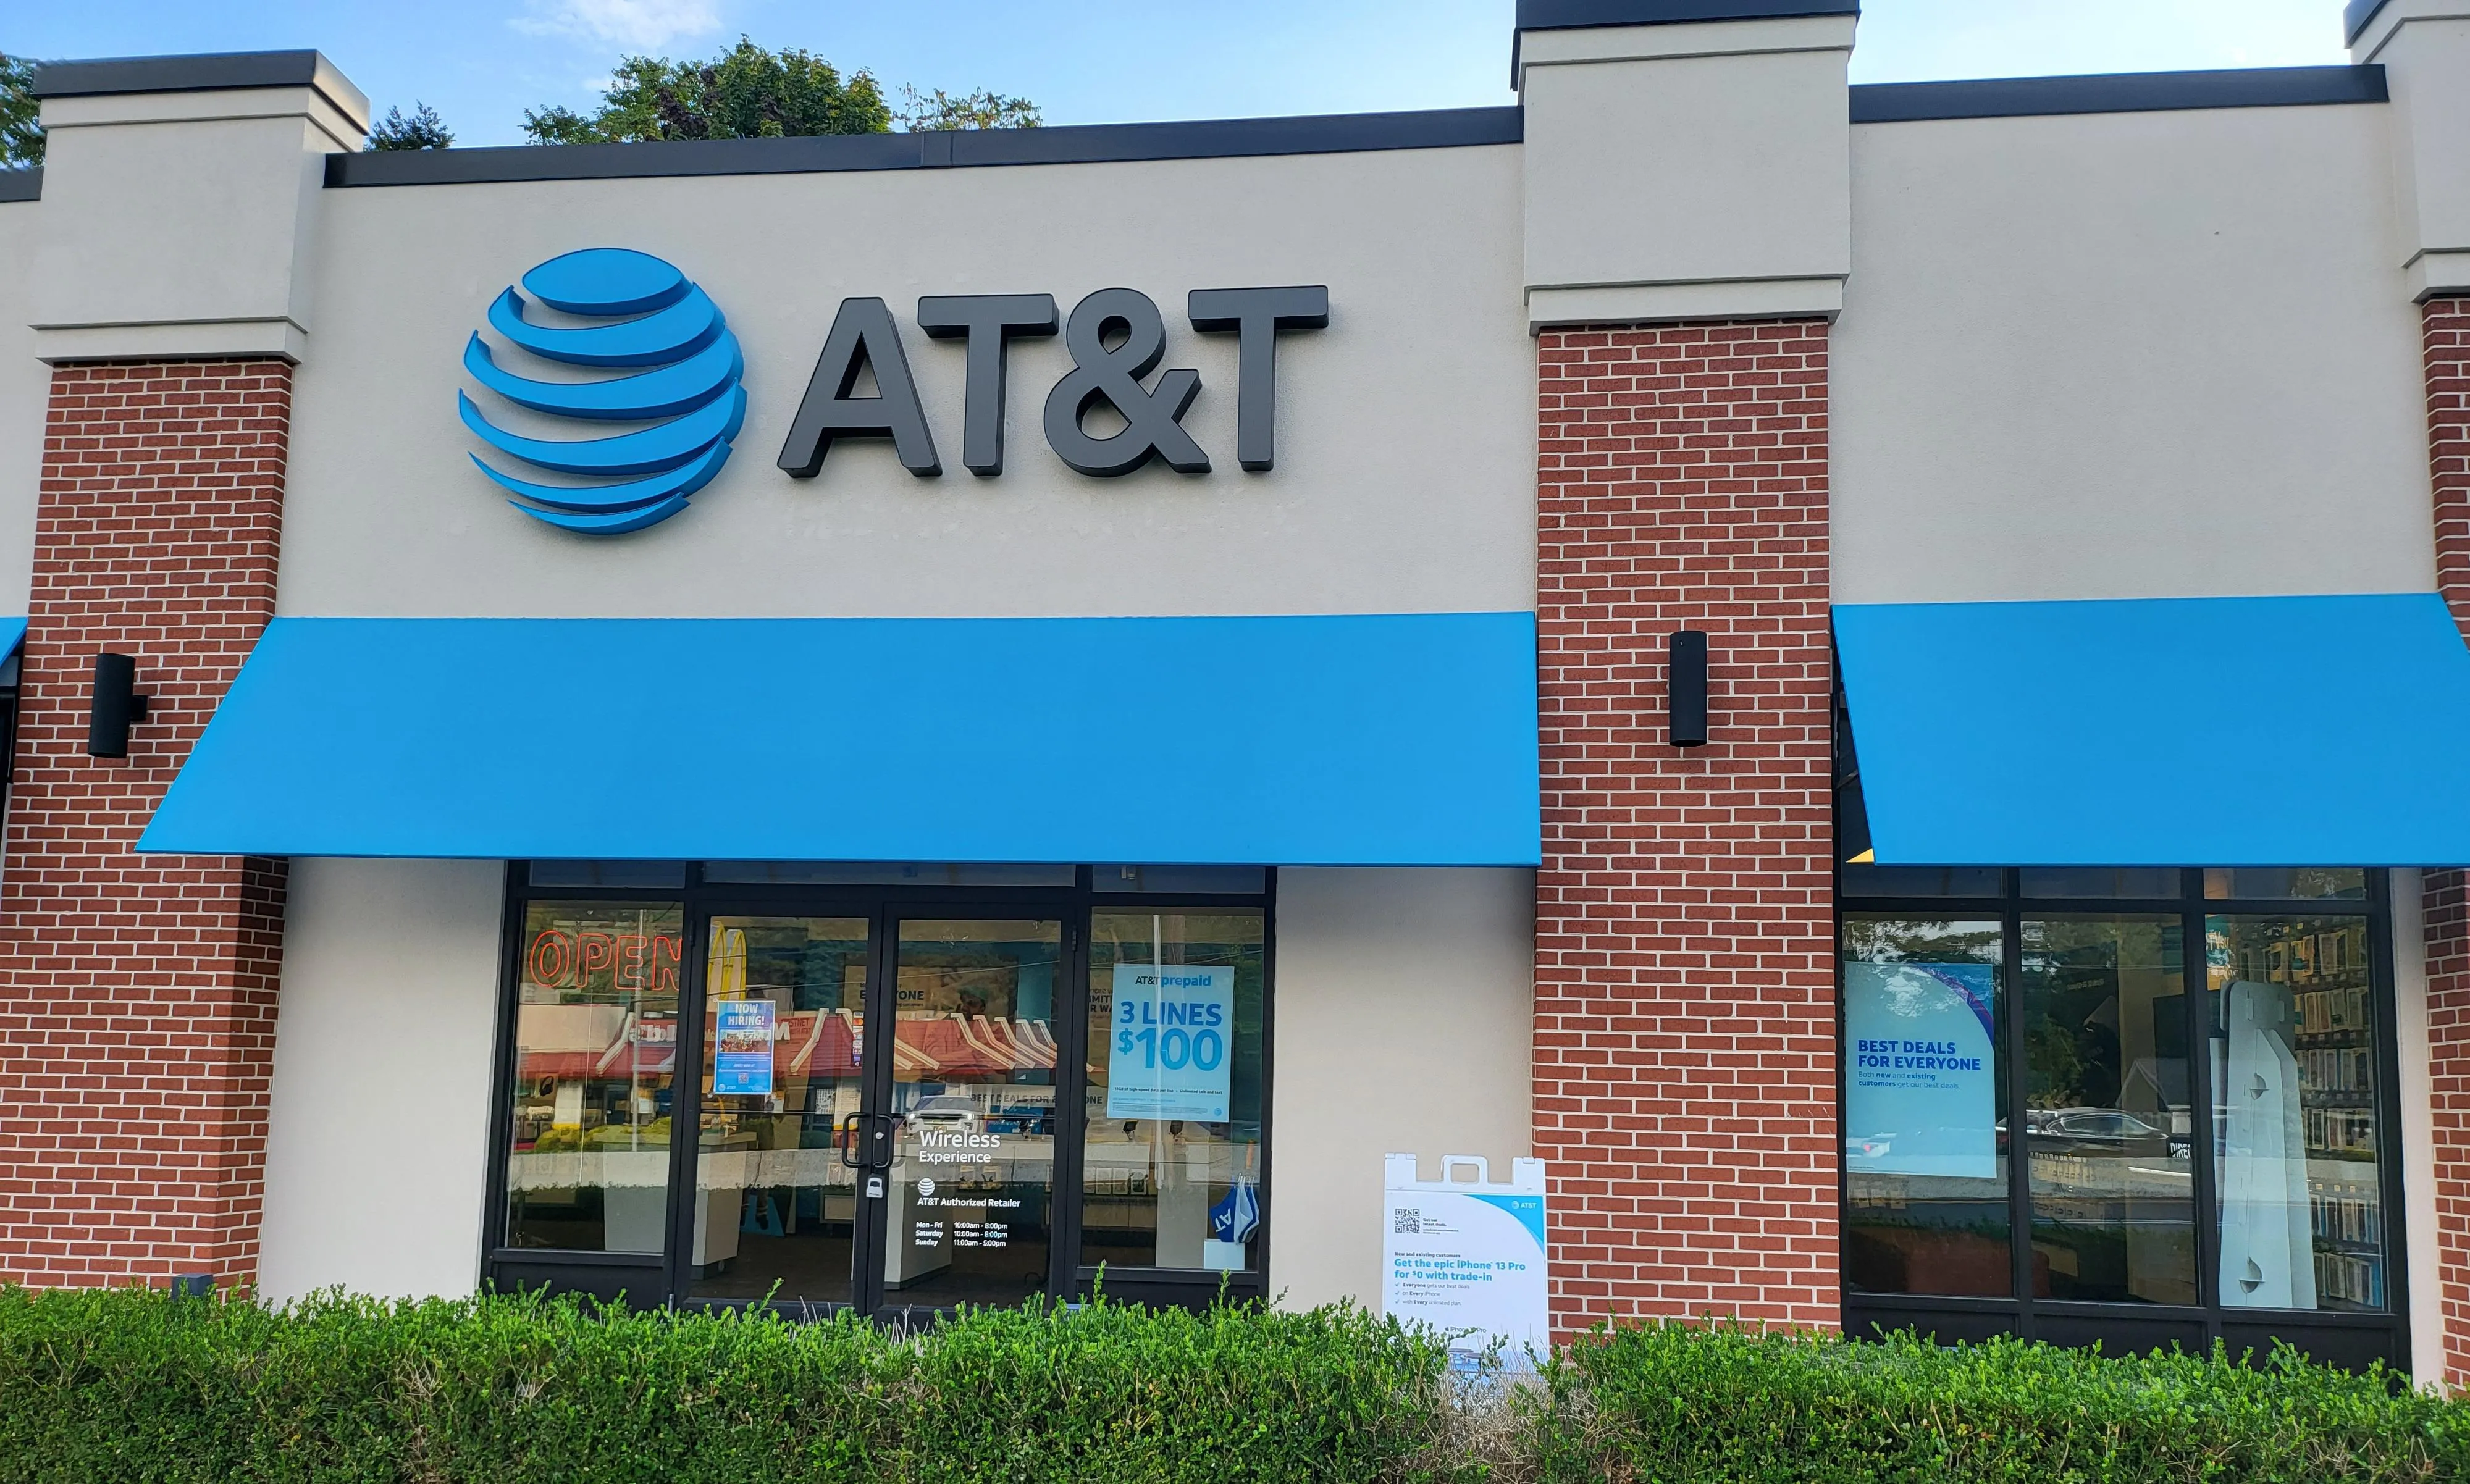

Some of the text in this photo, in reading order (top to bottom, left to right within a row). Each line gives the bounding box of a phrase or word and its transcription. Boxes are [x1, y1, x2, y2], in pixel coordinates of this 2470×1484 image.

[777, 285, 1329, 478] AT&T
[529, 930, 683, 991] OPEN
[1135, 975, 1211, 988] AT&T prepaid
[736, 1004, 758, 1013] NOW
[1119, 1001, 1222, 1026] 3 LINES
[728, 1015, 765, 1026] HIRING!
[1117, 1028, 1223, 1071] $100
[1858, 1040, 1956, 1055] BEST DEALS
[1858, 1055, 1981, 1070] FOR EVERYONE
[970, 1094, 996, 1102] BEST
[1030, 1095, 1049, 1103] FOR
[920, 1130, 1001, 1148] Wireless
[919, 1151, 991, 1165] Experience
[917, 1197, 1021, 1207] AT&T Authorized Retailer
[985, 1223, 1008, 1231] 8:00pm
[984, 1231, 1008, 1239] 8:00pm
[915, 1239, 938, 1247] Sunday
[983, 1239, 1006, 1247] 5:00pm
[1395, 1259, 1412, 1267] Get
[1414, 1259, 1432, 1268] the
[1434, 1260, 1454, 1270] epic
[1495, 1262, 1506, 1270] 13
[1508, 1262, 1526, 1270] Pro
[1394, 1270, 1492, 1281] for $0 with trade-in
